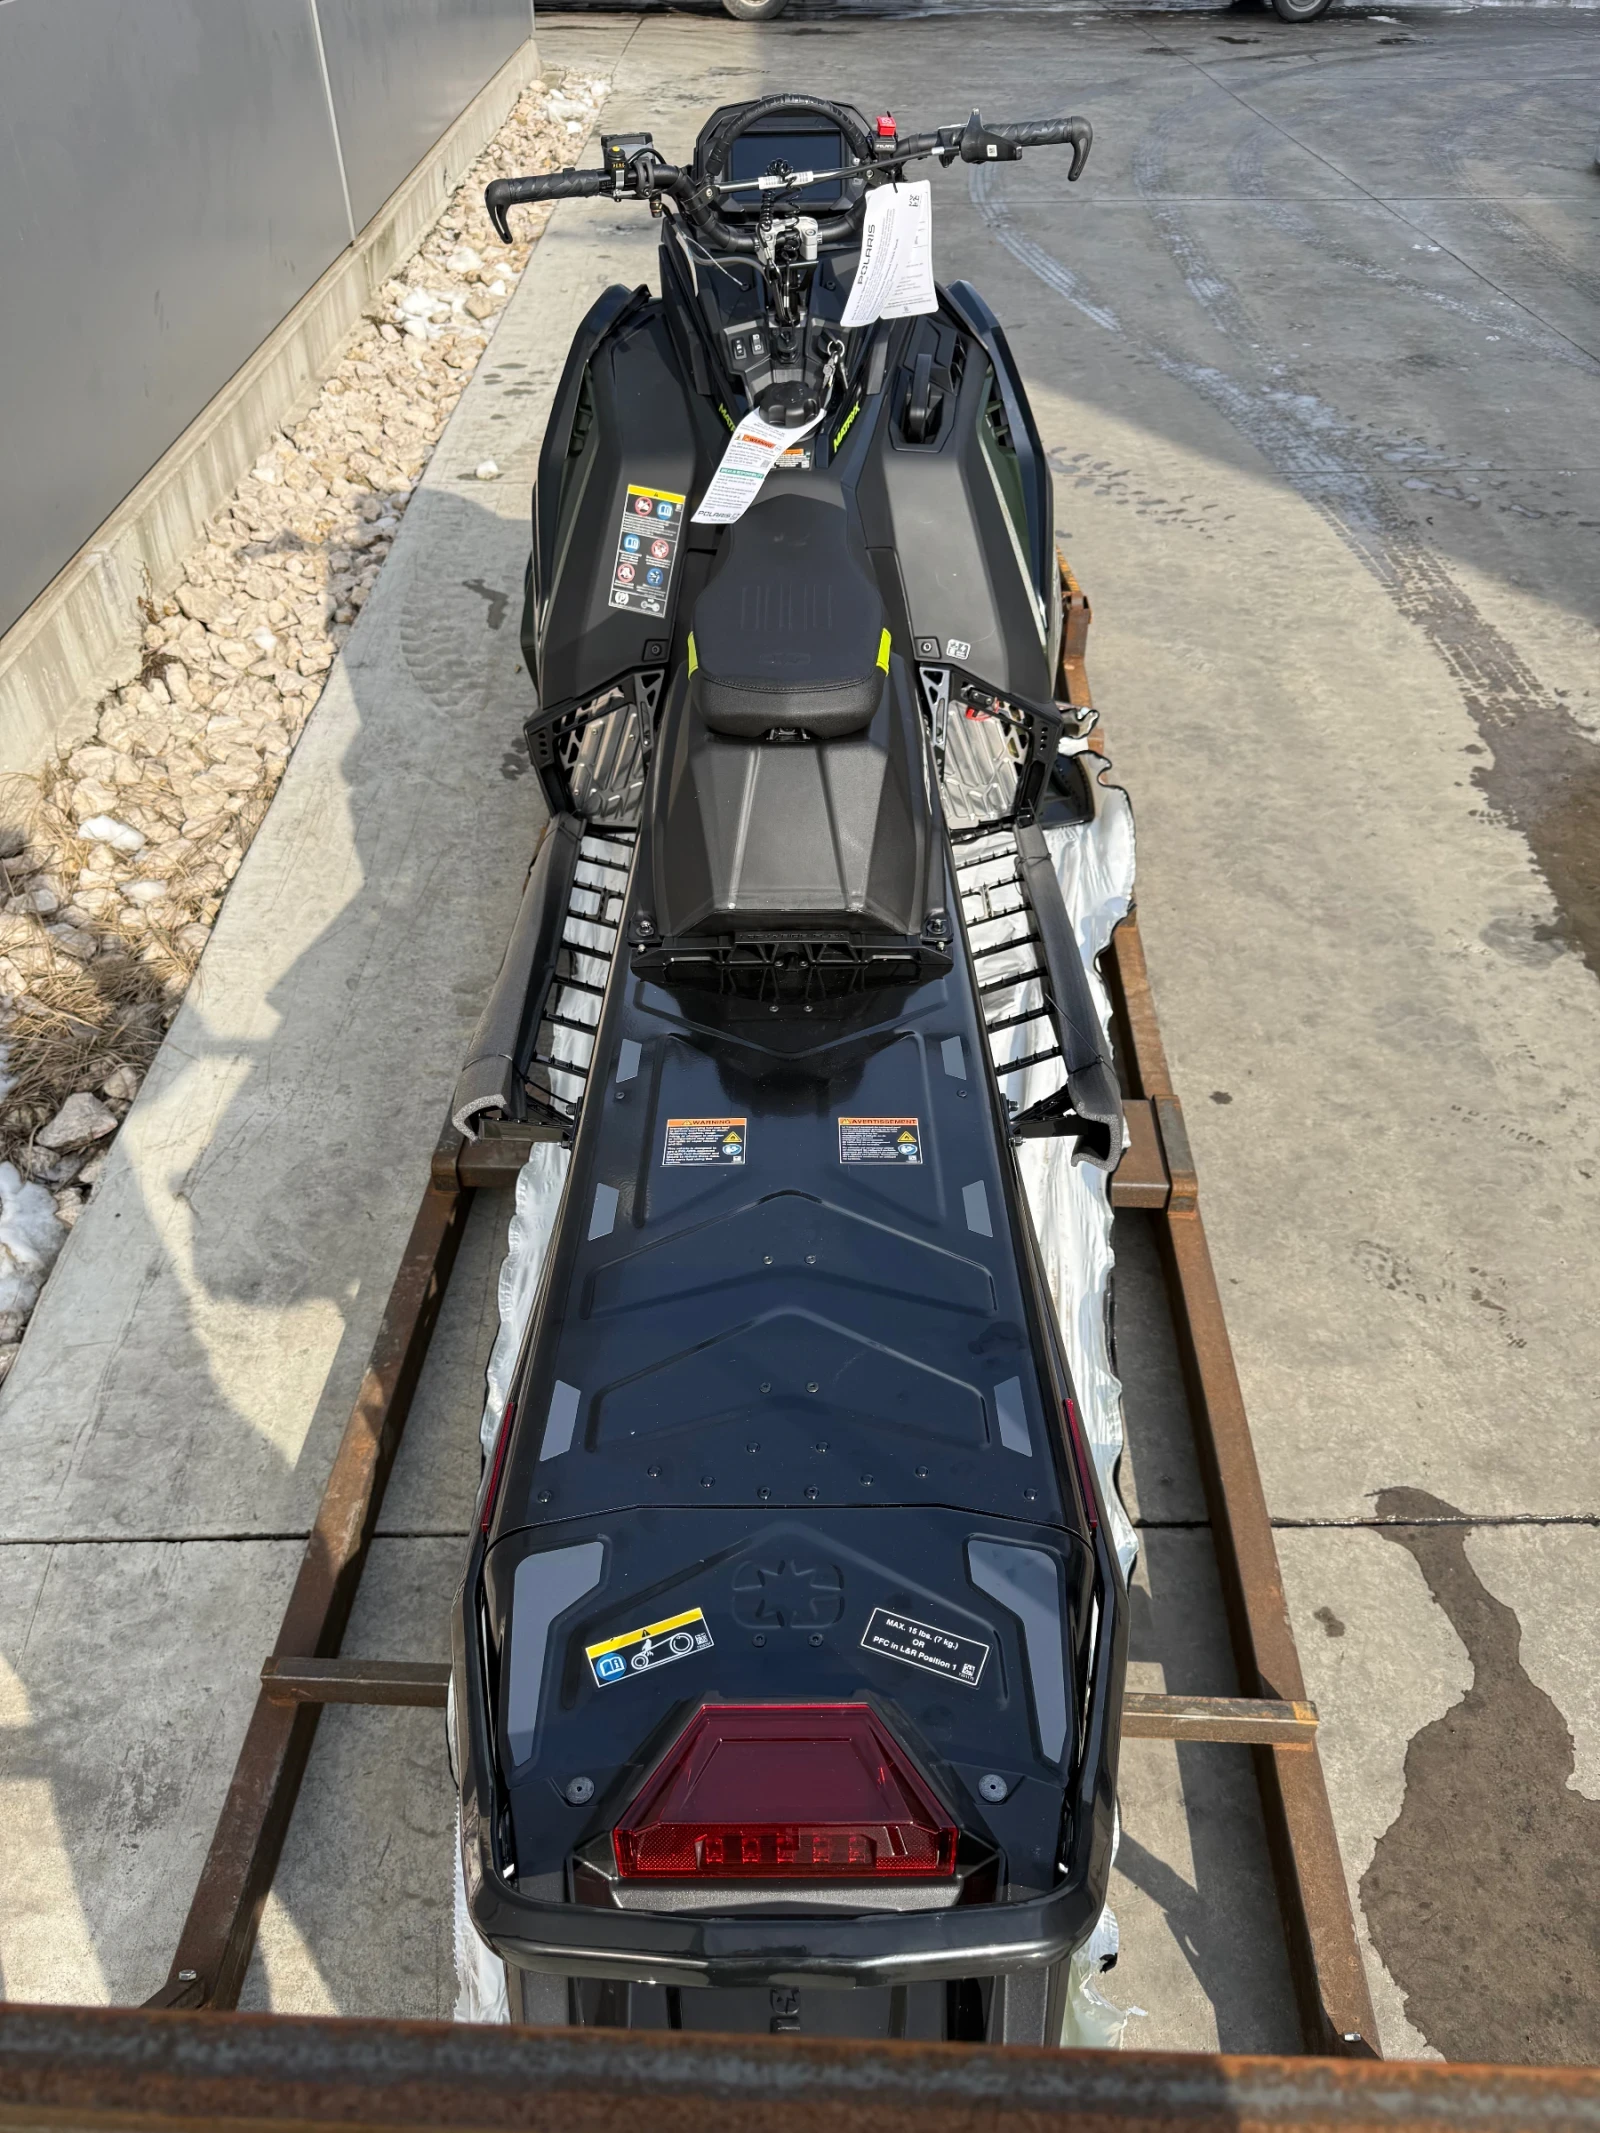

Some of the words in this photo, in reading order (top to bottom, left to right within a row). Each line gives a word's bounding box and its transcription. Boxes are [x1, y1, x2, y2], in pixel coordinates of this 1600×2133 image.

[857, 223, 876, 285] POLARIS
[833, 400, 860, 454] MATRYX
[697, 510, 731, 519] POLARIS
[886, 1618, 906, 1631] MAX.
[908, 1626, 918, 1635] 15
[918, 1629, 932, 1641] lbs.
[933, 1635, 943, 1644] (7
[943, 1638, 959, 1650] kg.)
[912, 1639, 925, 1648] OR
[872, 1635, 890, 1647] PFC
[890, 1642, 899, 1650] in
[899, 1645, 917, 1657] L&R
[918, 1651, 950, 1669] Position
